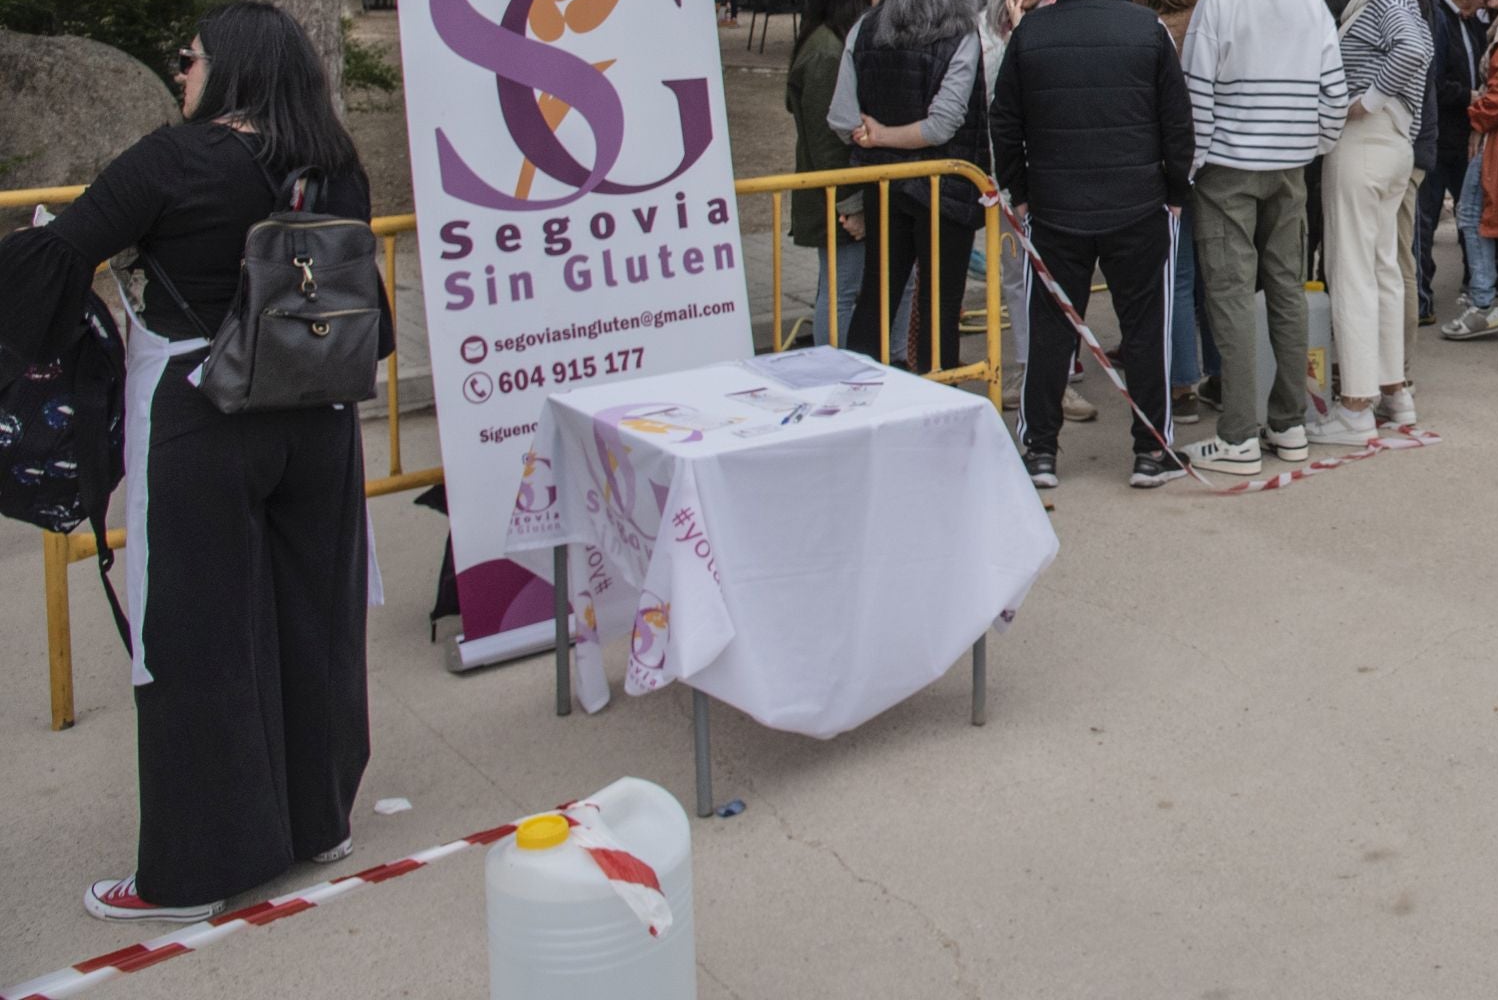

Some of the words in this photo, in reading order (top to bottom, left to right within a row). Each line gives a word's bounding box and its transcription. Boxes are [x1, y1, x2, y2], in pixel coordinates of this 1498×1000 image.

[439, 191, 730, 260] Segovia
[444, 264, 534, 311] Sin
[562, 241, 736, 292] Gluten
[494, 300, 736, 353] segoviasingluten@gmail.com
[498, 365, 546, 394] 604
[552, 355, 597, 384] 915
[604, 347, 646, 374] 177
